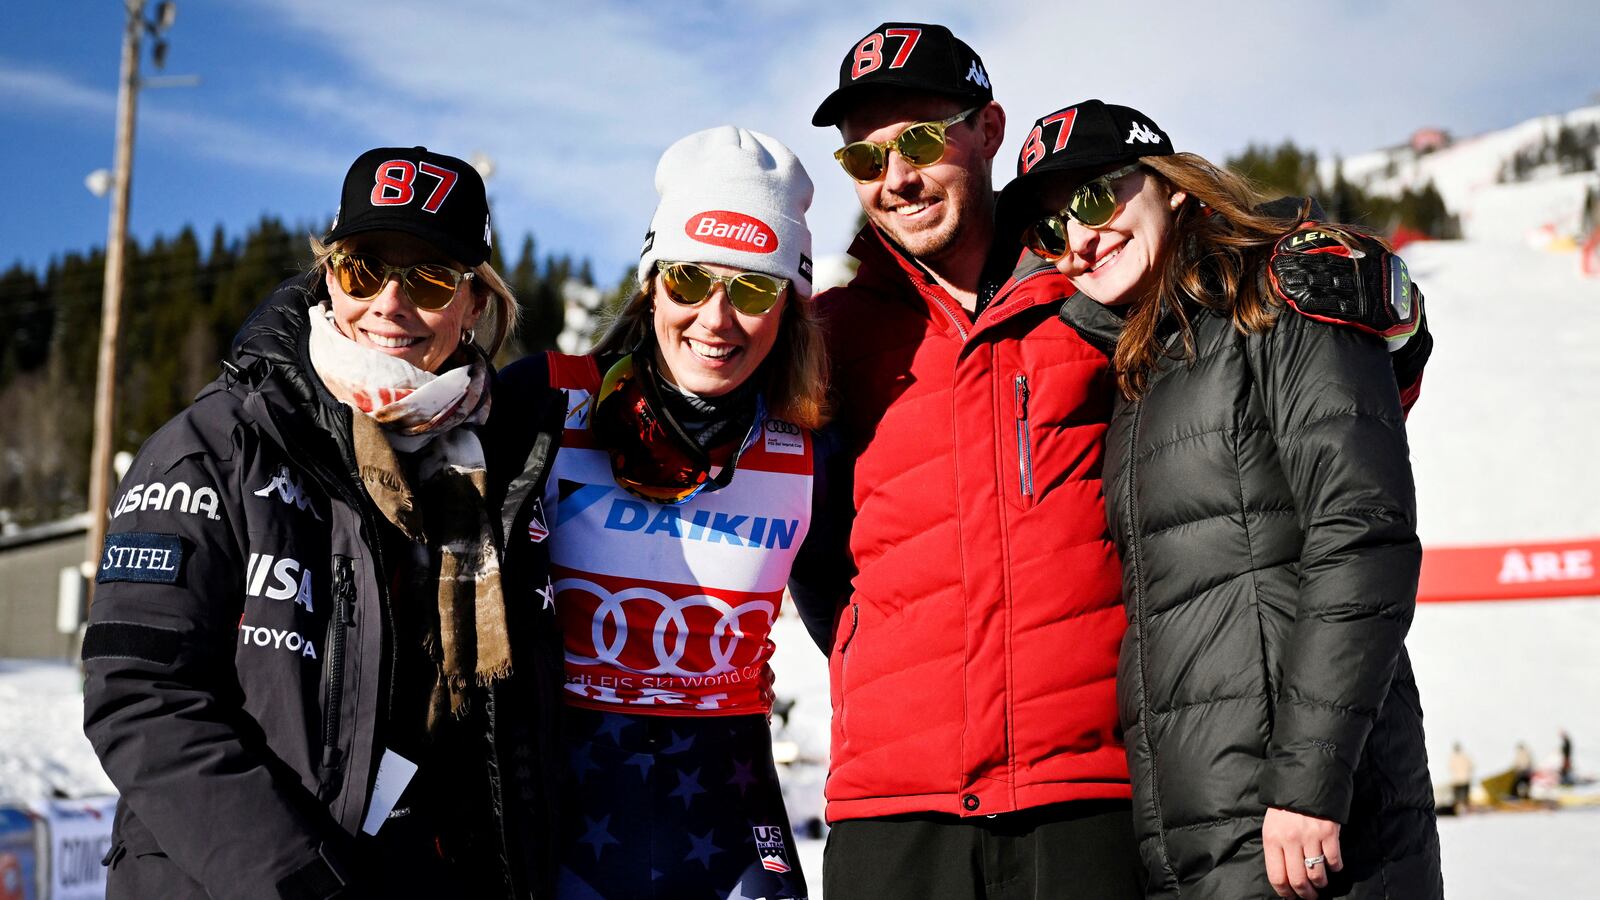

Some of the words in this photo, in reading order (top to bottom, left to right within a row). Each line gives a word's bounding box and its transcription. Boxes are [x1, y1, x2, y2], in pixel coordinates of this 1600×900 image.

[851, 28, 922, 80] 87
[1021, 108, 1078, 175] 87
[371, 159, 458, 214] 87
[695, 217, 768, 248] Barilla
[604, 498, 799, 550] DAIKIN
[103, 545, 175, 571] STIFEL
[241, 625, 317, 660] TOYOA
[642, 676, 673, 688] Ski
[680, 670, 741, 688] World
[754, 827, 782, 843] US
